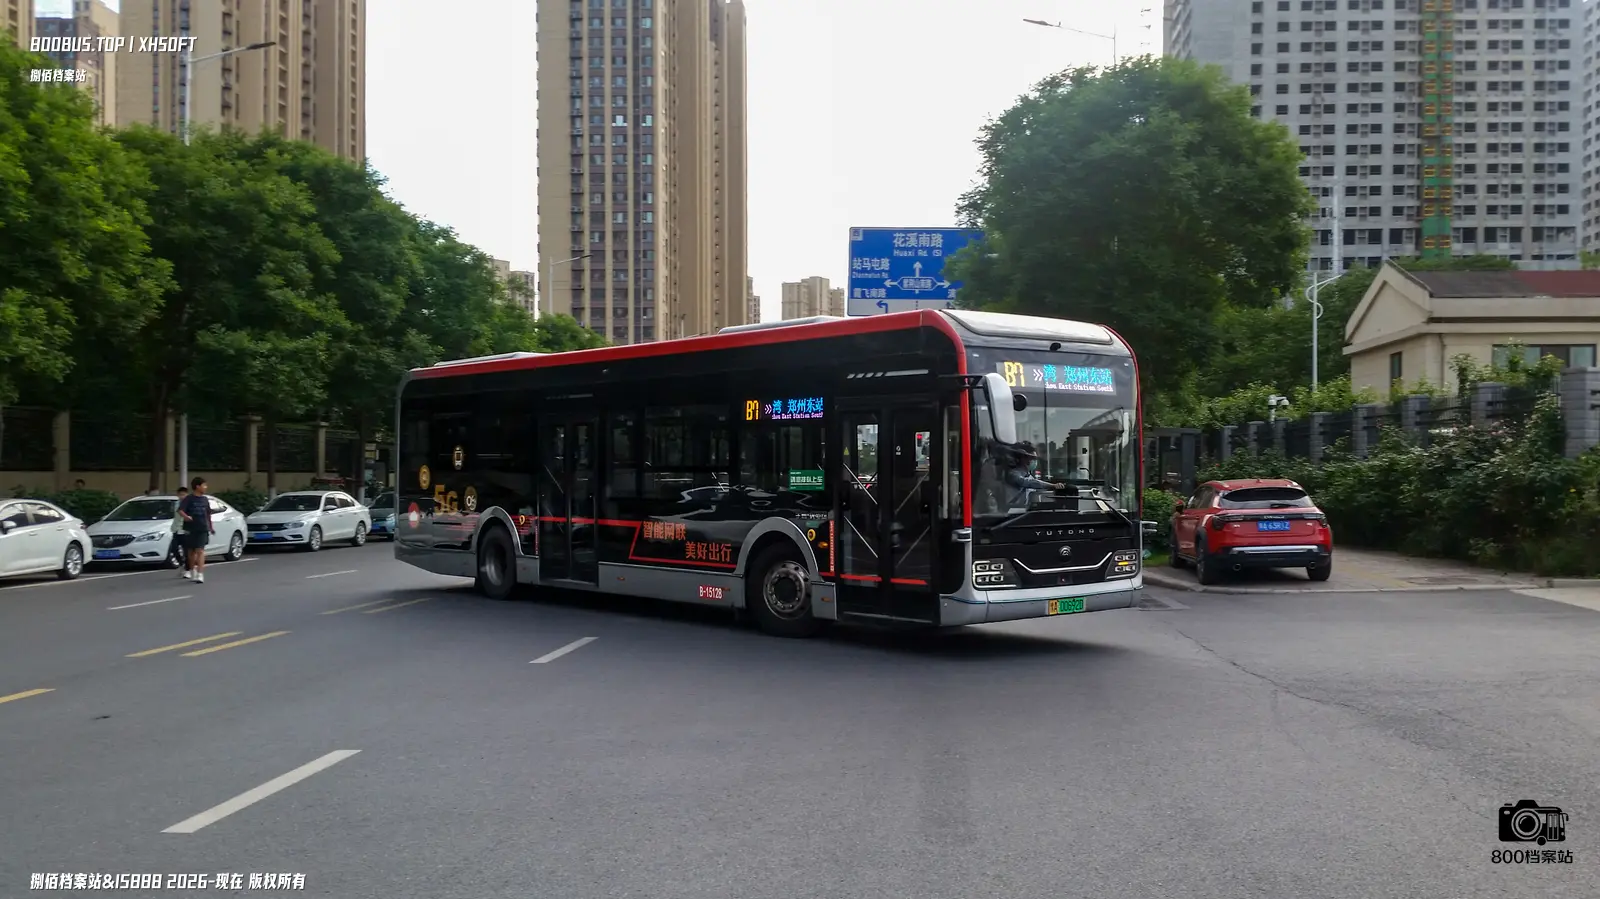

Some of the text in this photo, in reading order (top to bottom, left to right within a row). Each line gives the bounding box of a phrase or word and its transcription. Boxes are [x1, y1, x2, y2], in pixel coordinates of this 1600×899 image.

[893, 232, 943, 248] 花溪南路
[893, 249, 915, 257] Huaxi
[852, 258, 890, 271] 站马屯路
[1003, 361, 1025, 387] B7
[1064, 366, 1112, 385] 郑州东站
[1058, 383, 1072, 391] East
[1073, 384, 1096, 392] Station
[1097, 385, 1114, 393] South
[746, 400, 759, 420] B7
[787, 397, 823, 413] 郑州东站
[434, 484, 459, 515] 5G
[643, 521, 686, 540] 智能网联
[685, 541, 732, 562] 美好出行
[699, 586, 723, 599] B-15128
